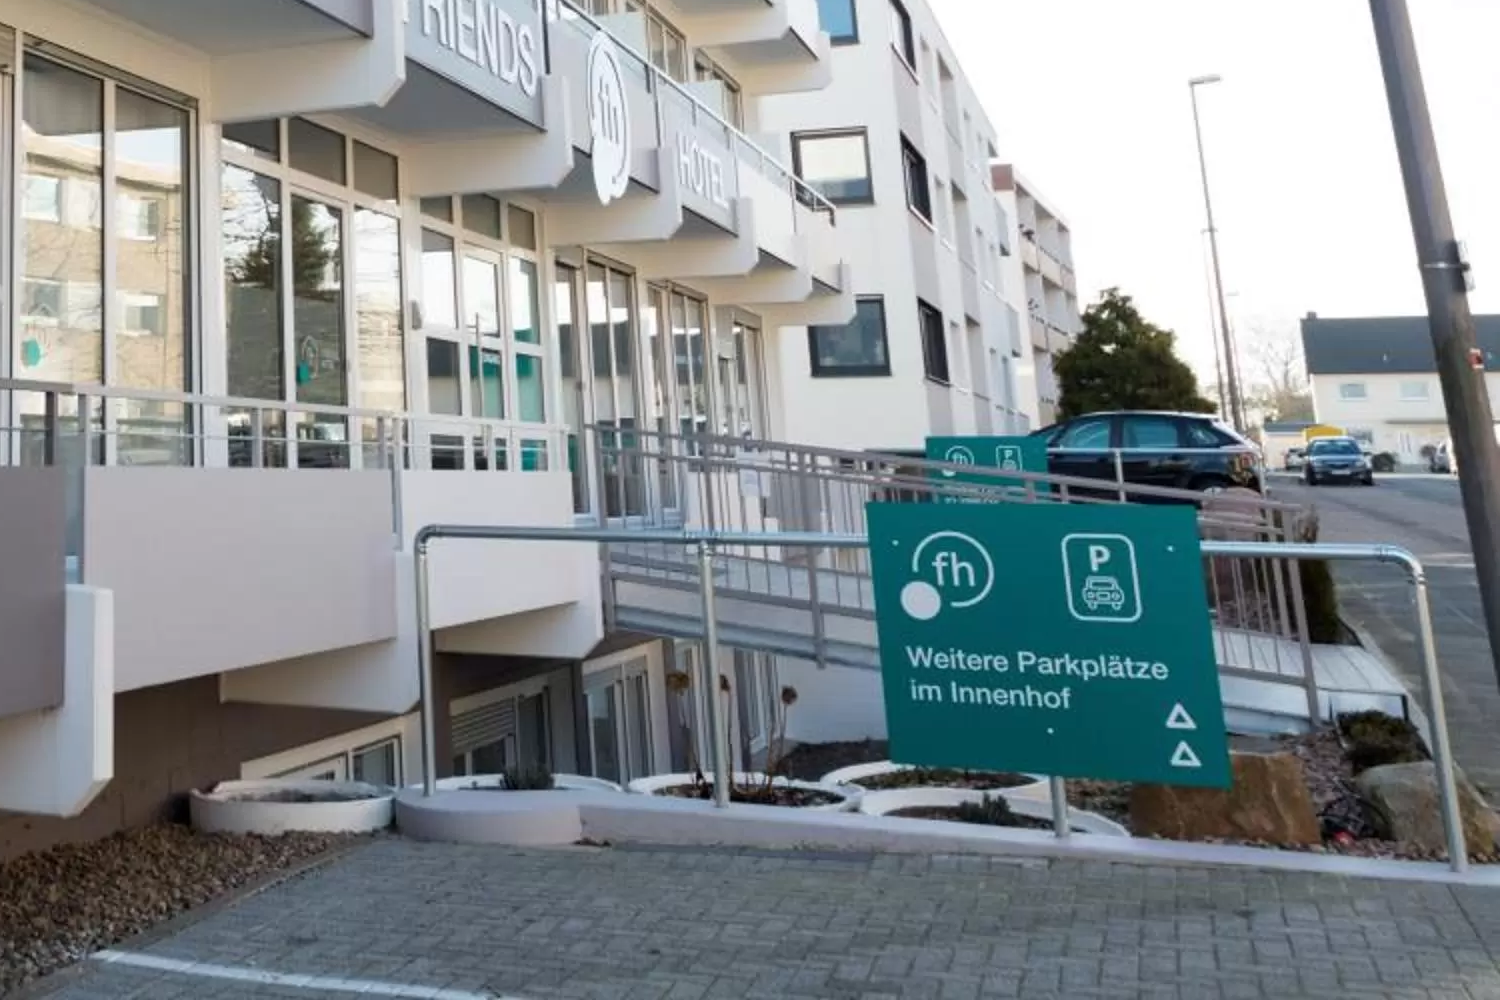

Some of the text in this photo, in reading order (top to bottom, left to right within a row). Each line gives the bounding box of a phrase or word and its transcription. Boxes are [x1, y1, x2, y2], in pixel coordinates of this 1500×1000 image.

[677, 131, 729, 209] HOTEL
[932, 552, 976, 587] fh
[1089, 545, 1111, 572] P
[905, 646, 1169, 681] Weitere Parkplätze
[910, 679, 1071, 709] im Innenhof
